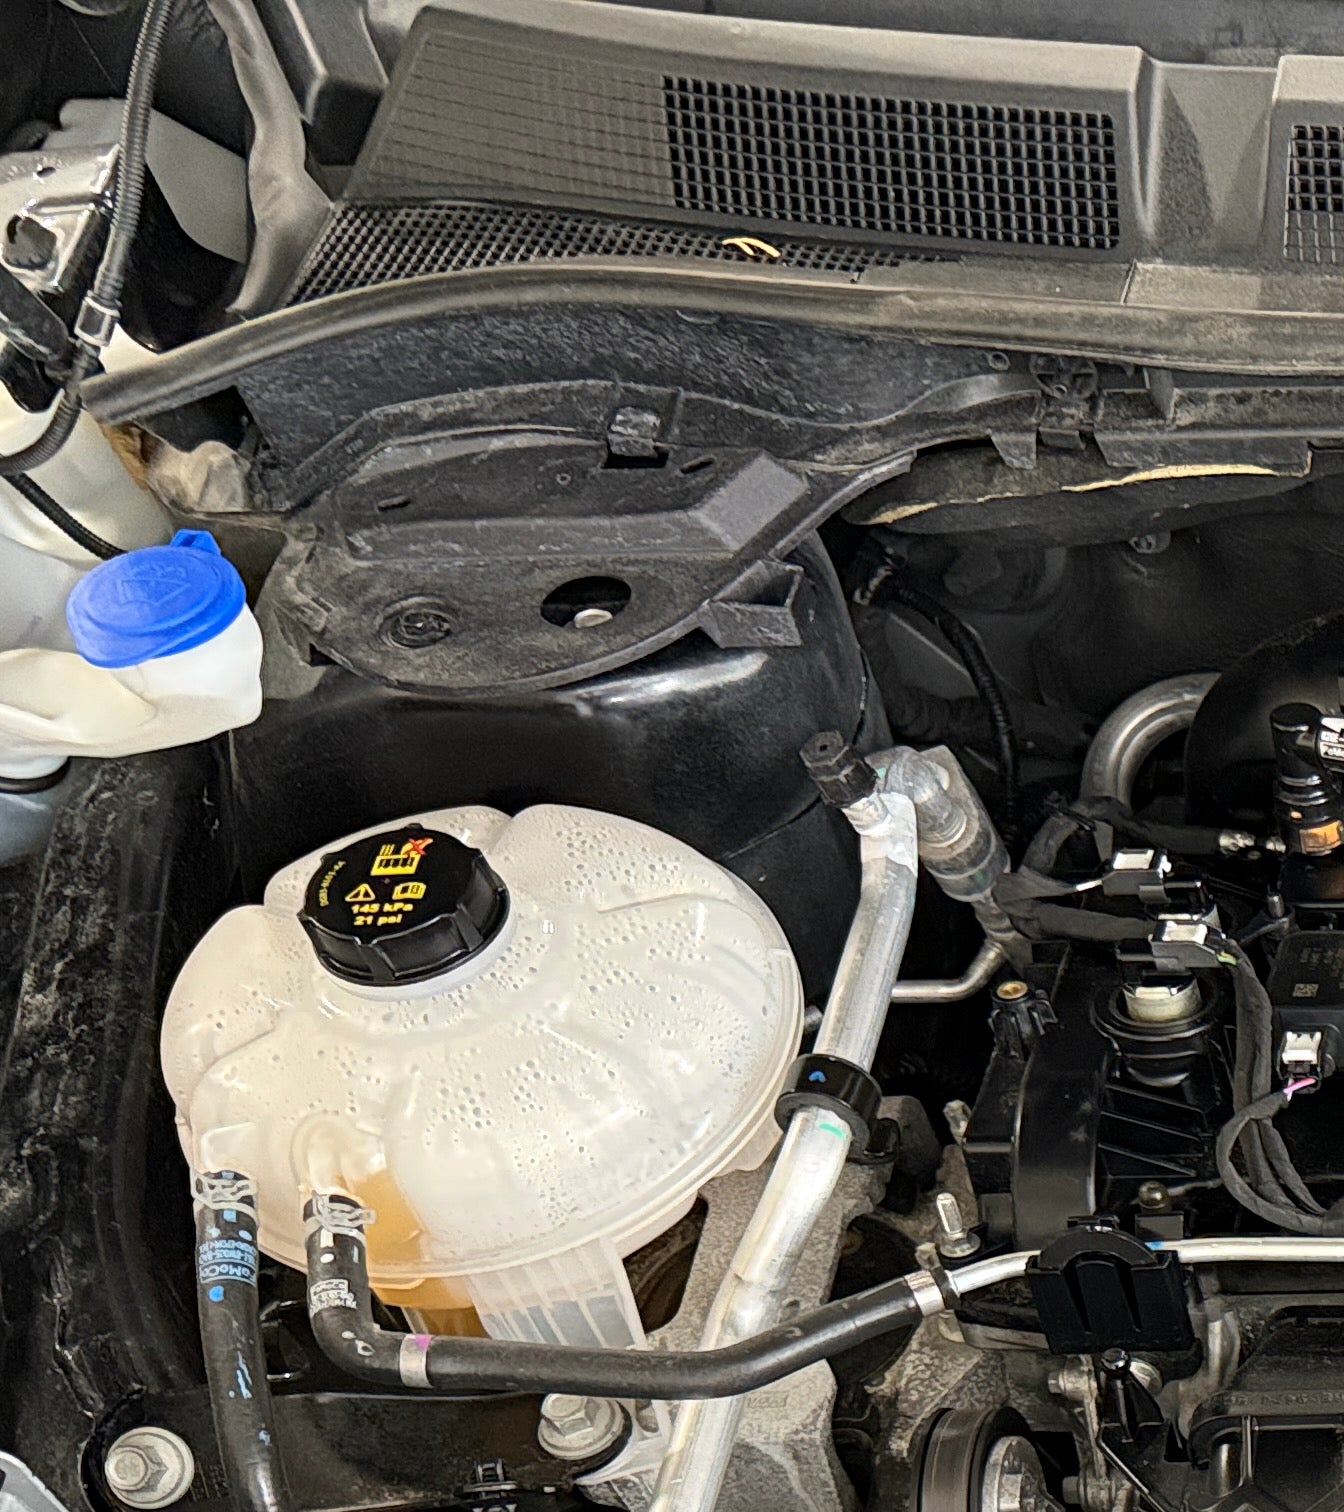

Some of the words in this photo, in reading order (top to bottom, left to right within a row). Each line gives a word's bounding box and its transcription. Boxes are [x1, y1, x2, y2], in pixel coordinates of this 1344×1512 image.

[351, 903, 380, 914] 145
[382, 902, 414, 912] kPa
[353, 915, 373, 926] 21
[377, 914, 403, 926] psi
